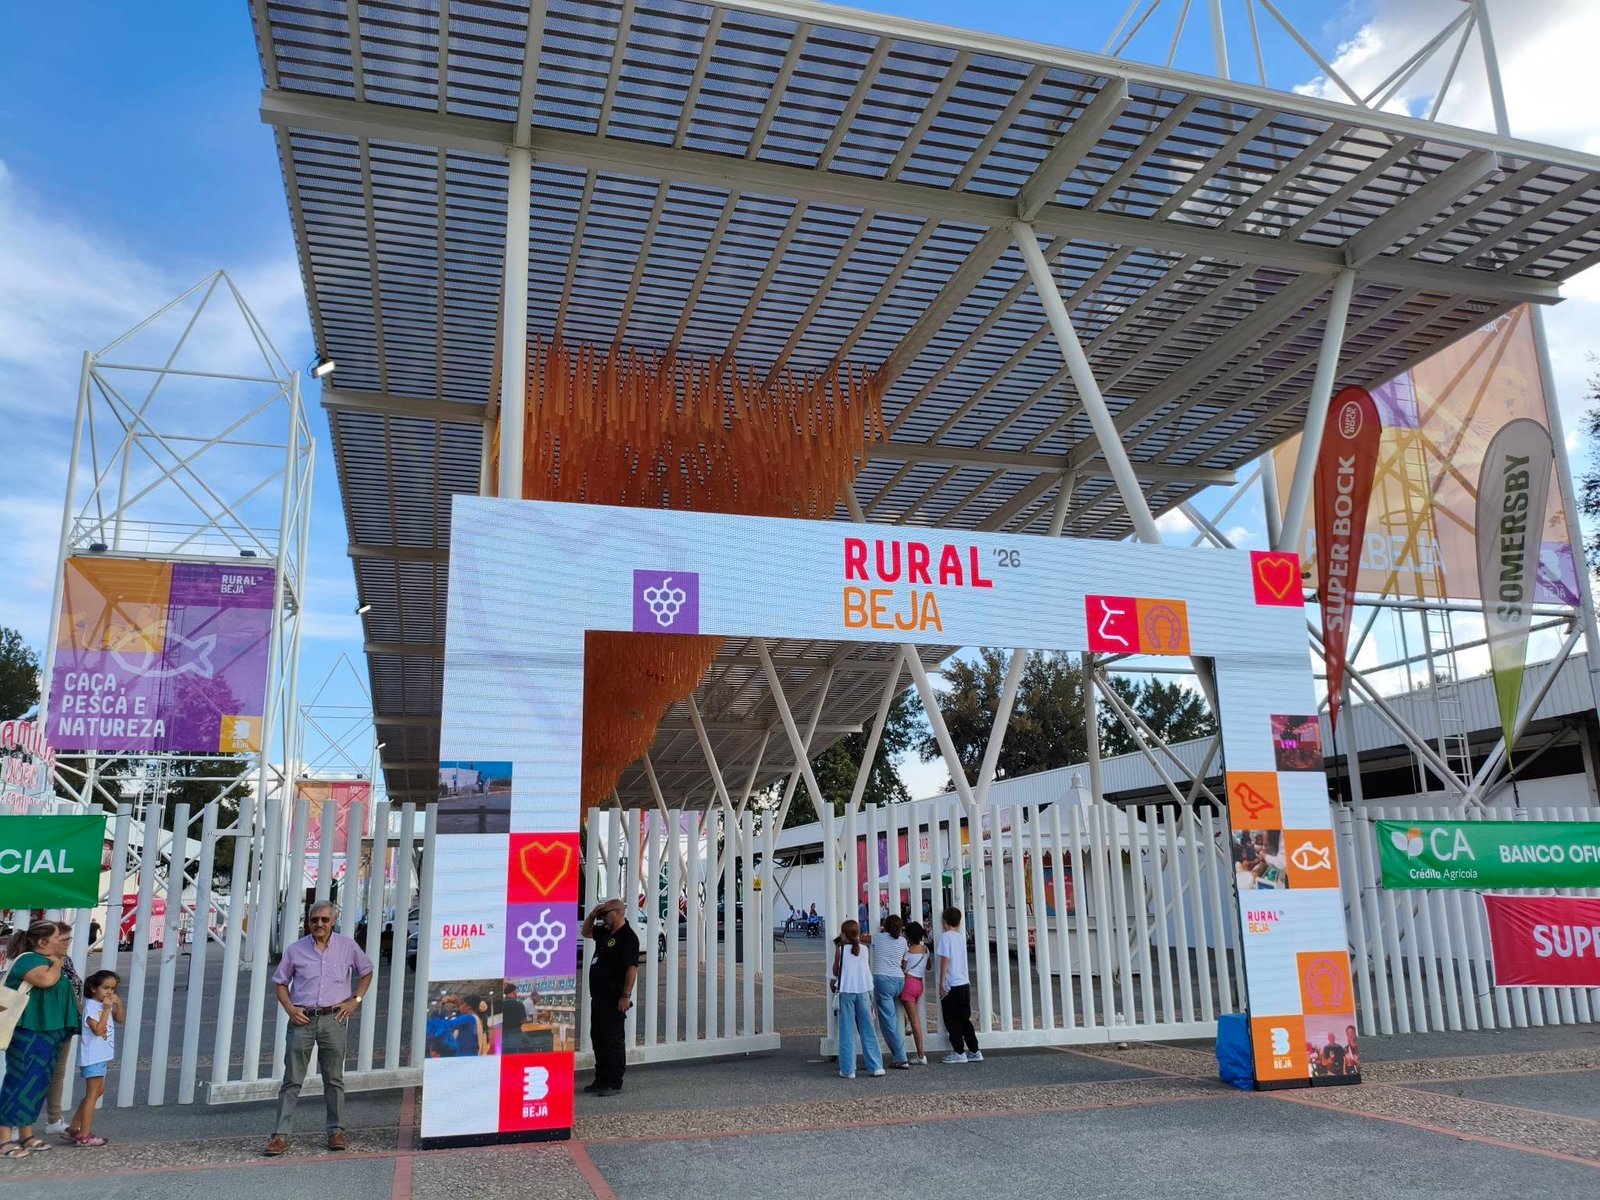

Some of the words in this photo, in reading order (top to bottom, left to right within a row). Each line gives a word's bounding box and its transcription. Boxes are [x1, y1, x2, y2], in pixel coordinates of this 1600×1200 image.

[1333, 454, 1356, 536] BOCK
[1496, 454, 1530, 623] SOMERSBY
[844, 537, 993, 588] RURAL
[221, 584, 245, 594] BEJA
[222, 574, 257, 586] RURAL
[1326, 543, 1350, 632] SUPER
[843, 586, 943, 633] BEJA
[64, 672, 126, 695] CAÇA,
[61, 694, 127, 714] PESCA
[133, 696, 146, 715] E
[58, 717, 165, 738] NATUREZA
[1430, 827, 1475, 862] CA
[1500, 844, 1565, 863] BANCO
[1569, 844, 1600, 863] OFI
[0, 849, 75, 874] CIAL
[1409, 868, 1441, 879] Crédito
[1247, 911, 1279, 922] RURAL
[443, 923, 486, 937] RURAL
[1248, 922, 1270, 933] BEJA
[442, 937, 471, 950] BEJA
[1273, 1059, 1292, 1070] BEJA
[522, 1105, 548, 1118] BEJA
